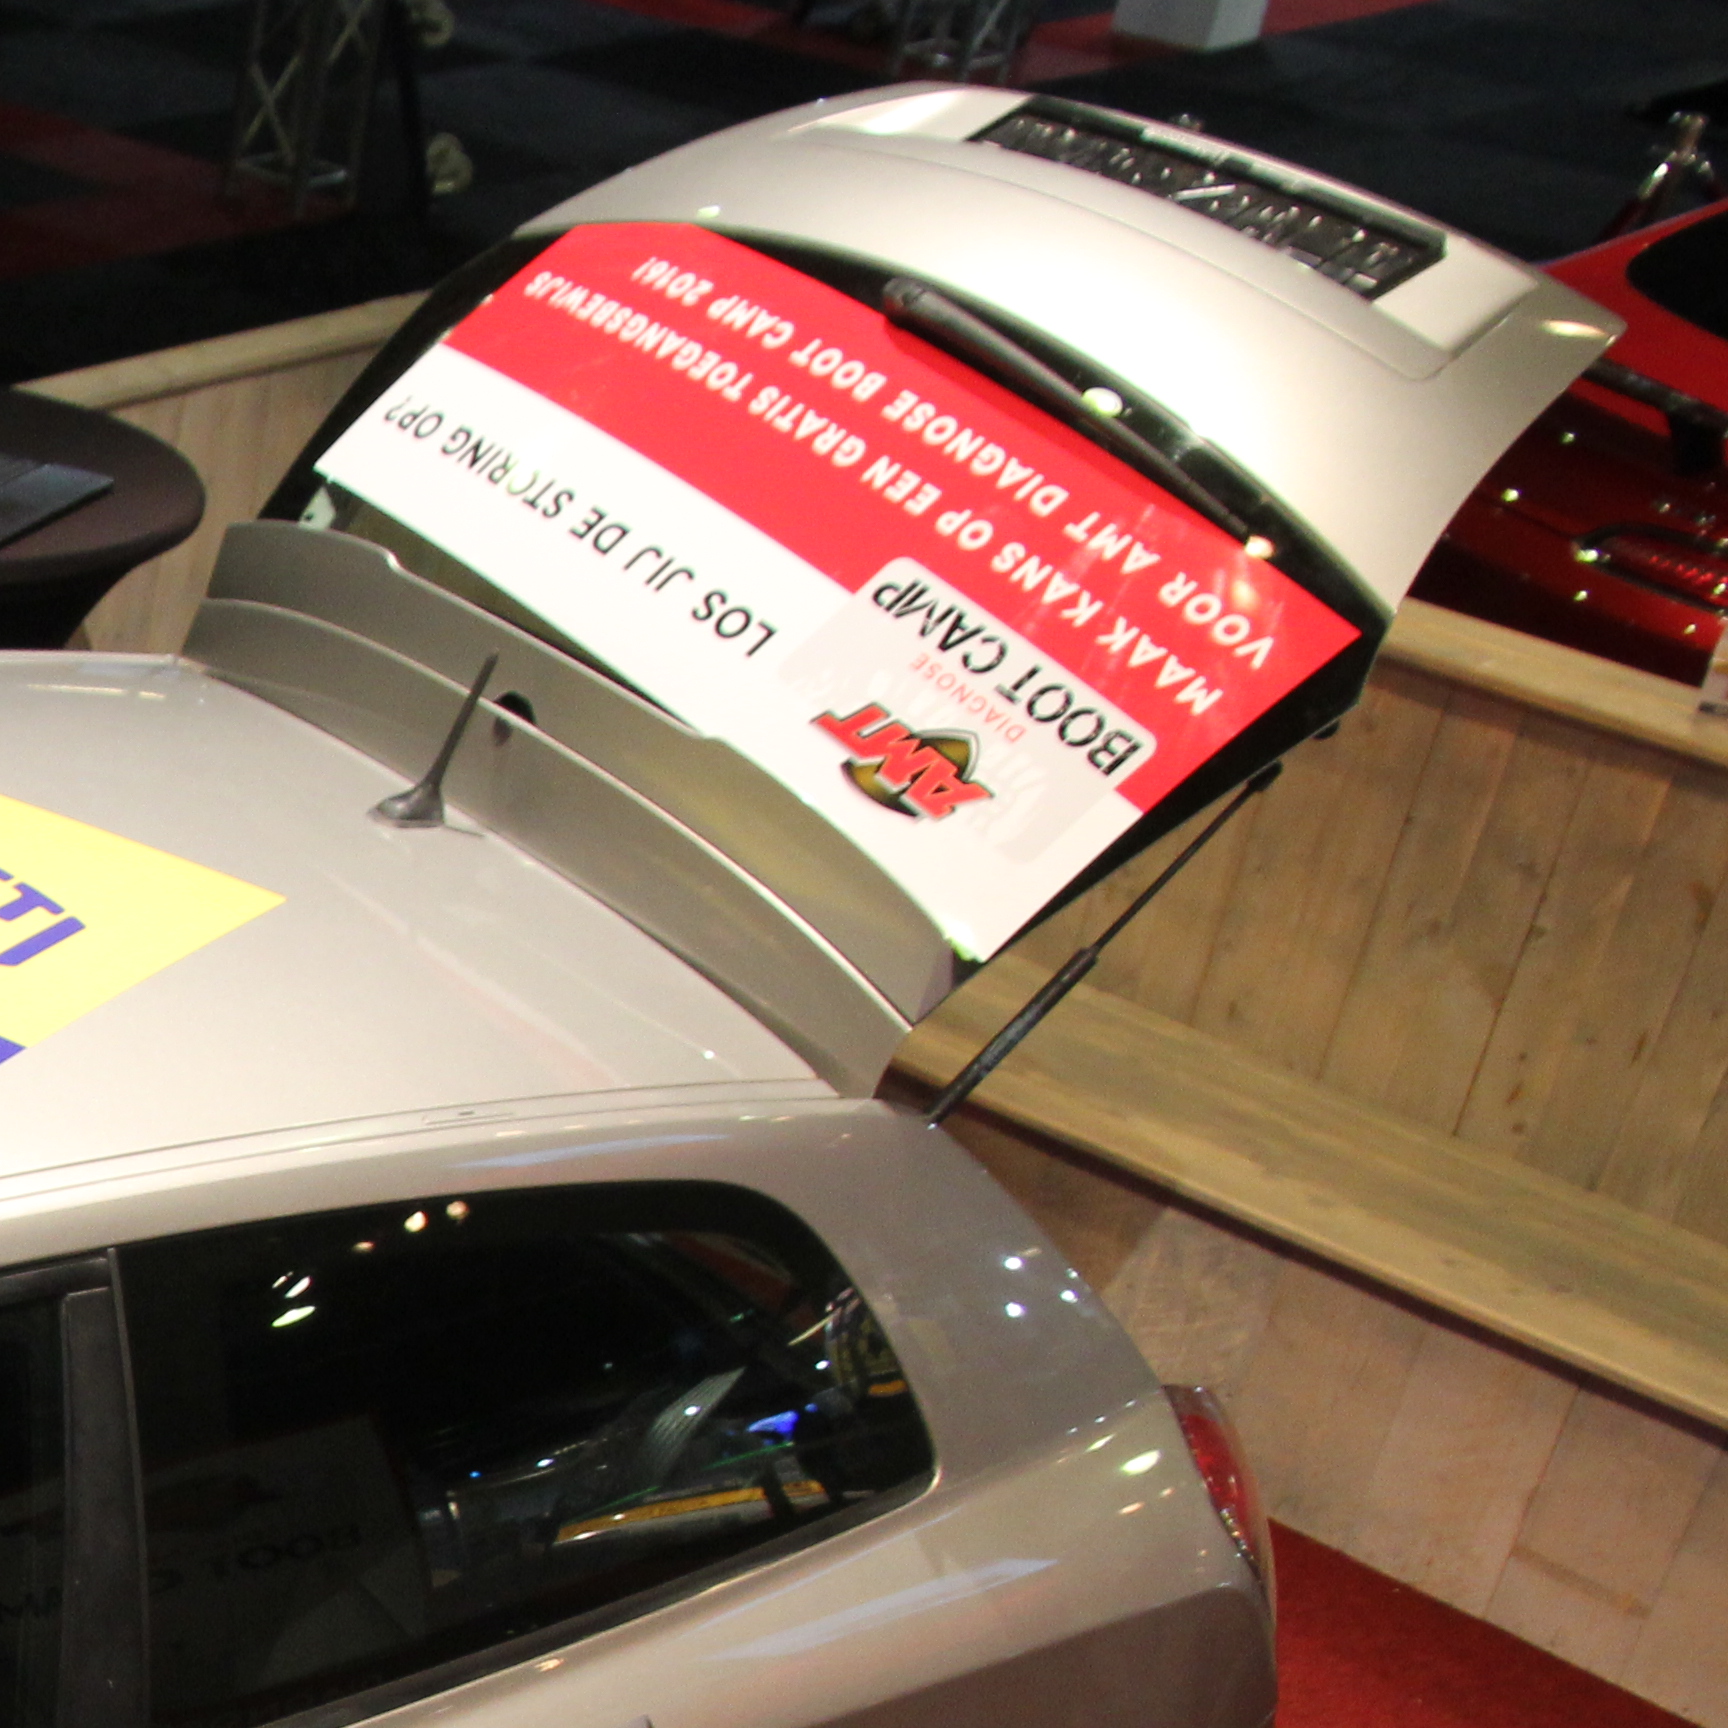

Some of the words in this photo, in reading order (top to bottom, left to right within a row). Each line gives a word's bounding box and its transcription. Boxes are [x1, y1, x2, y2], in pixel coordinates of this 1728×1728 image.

[630, 255, 713, 306] 2016!
[523, 270, 755, 402] TOEGANGSBEWIJS
[706, 294, 795, 349] CAMP
[790, 338, 888, 403] BOOT
[384, 394, 444, 439] OP?
[748, 384, 867, 467] GRATIS
[881, 388, 1070, 518] DIAGNOSE
[861, 455, 943, 516] EEN
[569, 506, 632, 555] DE
[935, 508, 994, 551] OP
[1063, 511, 1160, 576] AMT
[624, 545, 695, 591] JIJ
[991, 541, 1104, 627] KANS
[691, 589, 777, 658] LOS
[872, 579, 1009, 675] CAMP
[1158, 571, 1275, 670] VOOR
[910, 652, 1027, 744] DIAGNOSE
[1096, 616, 1223, 717] MAAK
[995, 665, 1144, 776] BOOT
[809, 701, 996, 820] AMT
